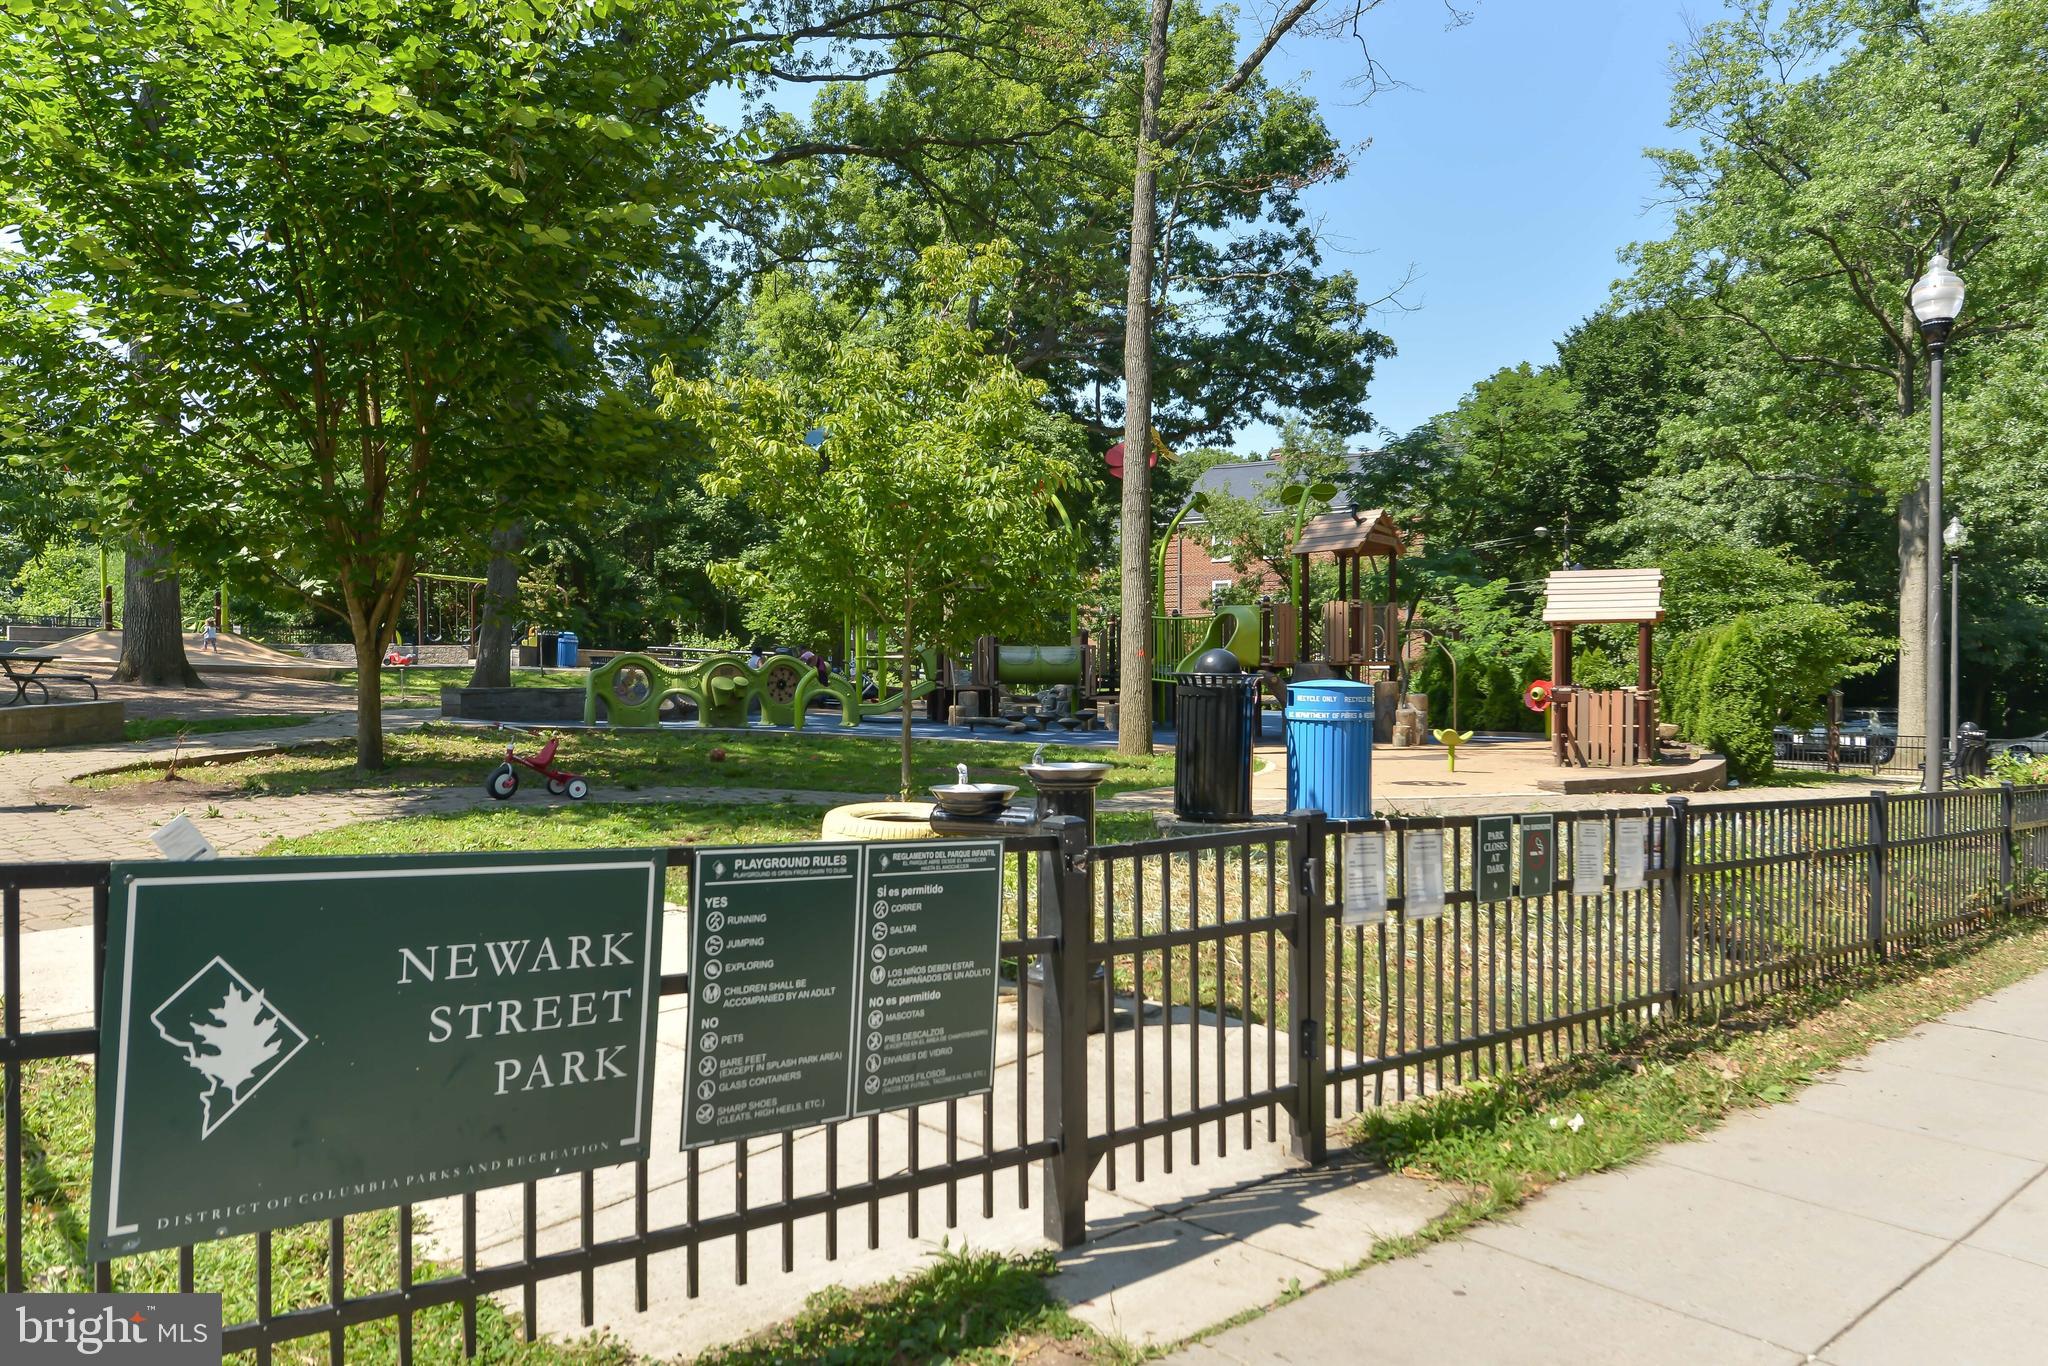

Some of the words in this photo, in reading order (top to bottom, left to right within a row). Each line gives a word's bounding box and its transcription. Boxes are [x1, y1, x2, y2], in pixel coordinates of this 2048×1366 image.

[1322, 695, 1337, 703] ONLY
[1487, 831, 1504, 840] PARK
[1483, 842, 1509, 852] CLOSES
[892, 851, 934, 861] REGLAMENTO
[935, 851, 946, 859] DEL
[947, 850, 970, 858] PARQUE
[971, 849, 996, 857] INFANTIL
[1491, 853, 1500, 863] AT
[734, 856, 811, 870] PLAYGROUND
[812, 855, 847, 866] RULES
[1486, 864, 1505, 874] DARK
[888, 888, 900, 897] es
[901, 884, 944, 898] permitido
[704, 896, 728, 909] YES
[890, 902, 922, 913] CORRER
[727, 914, 767, 925] RUNNING
[889, 924, 917, 935] SALTAR
[726, 937, 765, 949] JUMPING
[888, 944, 928, 956] EXPLORAR
[397, 932, 634, 984] NEWARK
[725, 959, 774, 972] EXPLORING
[887, 968, 902, 978] LOS
[903, 965, 926, 976] NIÑOS
[927, 963, 952, 974] DEBEN
[952, 960, 975, 970] ESTAR
[942, 972, 953, 980] DE
[954, 970, 964, 979] UN
[964, 967, 992, 978] ADULTO
[724, 983, 767, 996] CHILDREN
[768, 981, 794, 992] SHALL
[795, 979, 807, 988] BE
[723, 994, 784, 1008] ACCOMPANIED
[785, 992, 797, 1001] BY
[798, 990, 810, 999] AN
[810, 986, 836, 998] ADULT
[868, 996, 884, 1008] NO
[885, 996, 897, 1006] es
[898, 990, 942, 1006] permitido
[428, 988, 632, 1043] STREET
[885, 1008, 925, 1022] MASCOTAS
[701, 1016, 719, 1030] NO
[721, 1033, 744, 1045] PETS
[884, 1033, 901, 1044] PIES
[902, 1027, 945, 1040] DESCALZOS
[719, 1055, 743, 1068] BARE
[744, 1053, 767, 1064] FEET
[883, 1052, 917, 1066] ENVASES
[918, 1050, 928, 1060] DE
[929, 1046, 953, 1057] VIDRIO
[494, 1045, 627, 1096] PARK
[719, 1064, 755, 1079] (EXCEPT
[756, 1062, 765, 1072] IN
[766, 1058, 798, 1070] SPLASH
[798, 1055, 819, 1066] PARK
[819, 1051, 842, 1062] AREA)
[718, 1079, 748, 1093] GLASS
[748, 1070, 802, 1087] CONTAINERS
[882, 1073, 914, 1087] ZAPATOS
[916, 1068, 946, 1080] FILOSOS
[717, 1102, 747, 1116] SHARP
[748, 1097, 778, 1108] SHOES
[754, 1108, 775, 1118] HIGH
[156, 1201, 260, 1230] DISTRICT
[267, 1196, 293, 1210] OF
[298, 1178, 399, 1204] COLUMBIA
[406, 1168, 460, 1186] PARKS
[467, 1161, 501, 1175] AND
[506, 1141, 610, 1168] RECREATION
